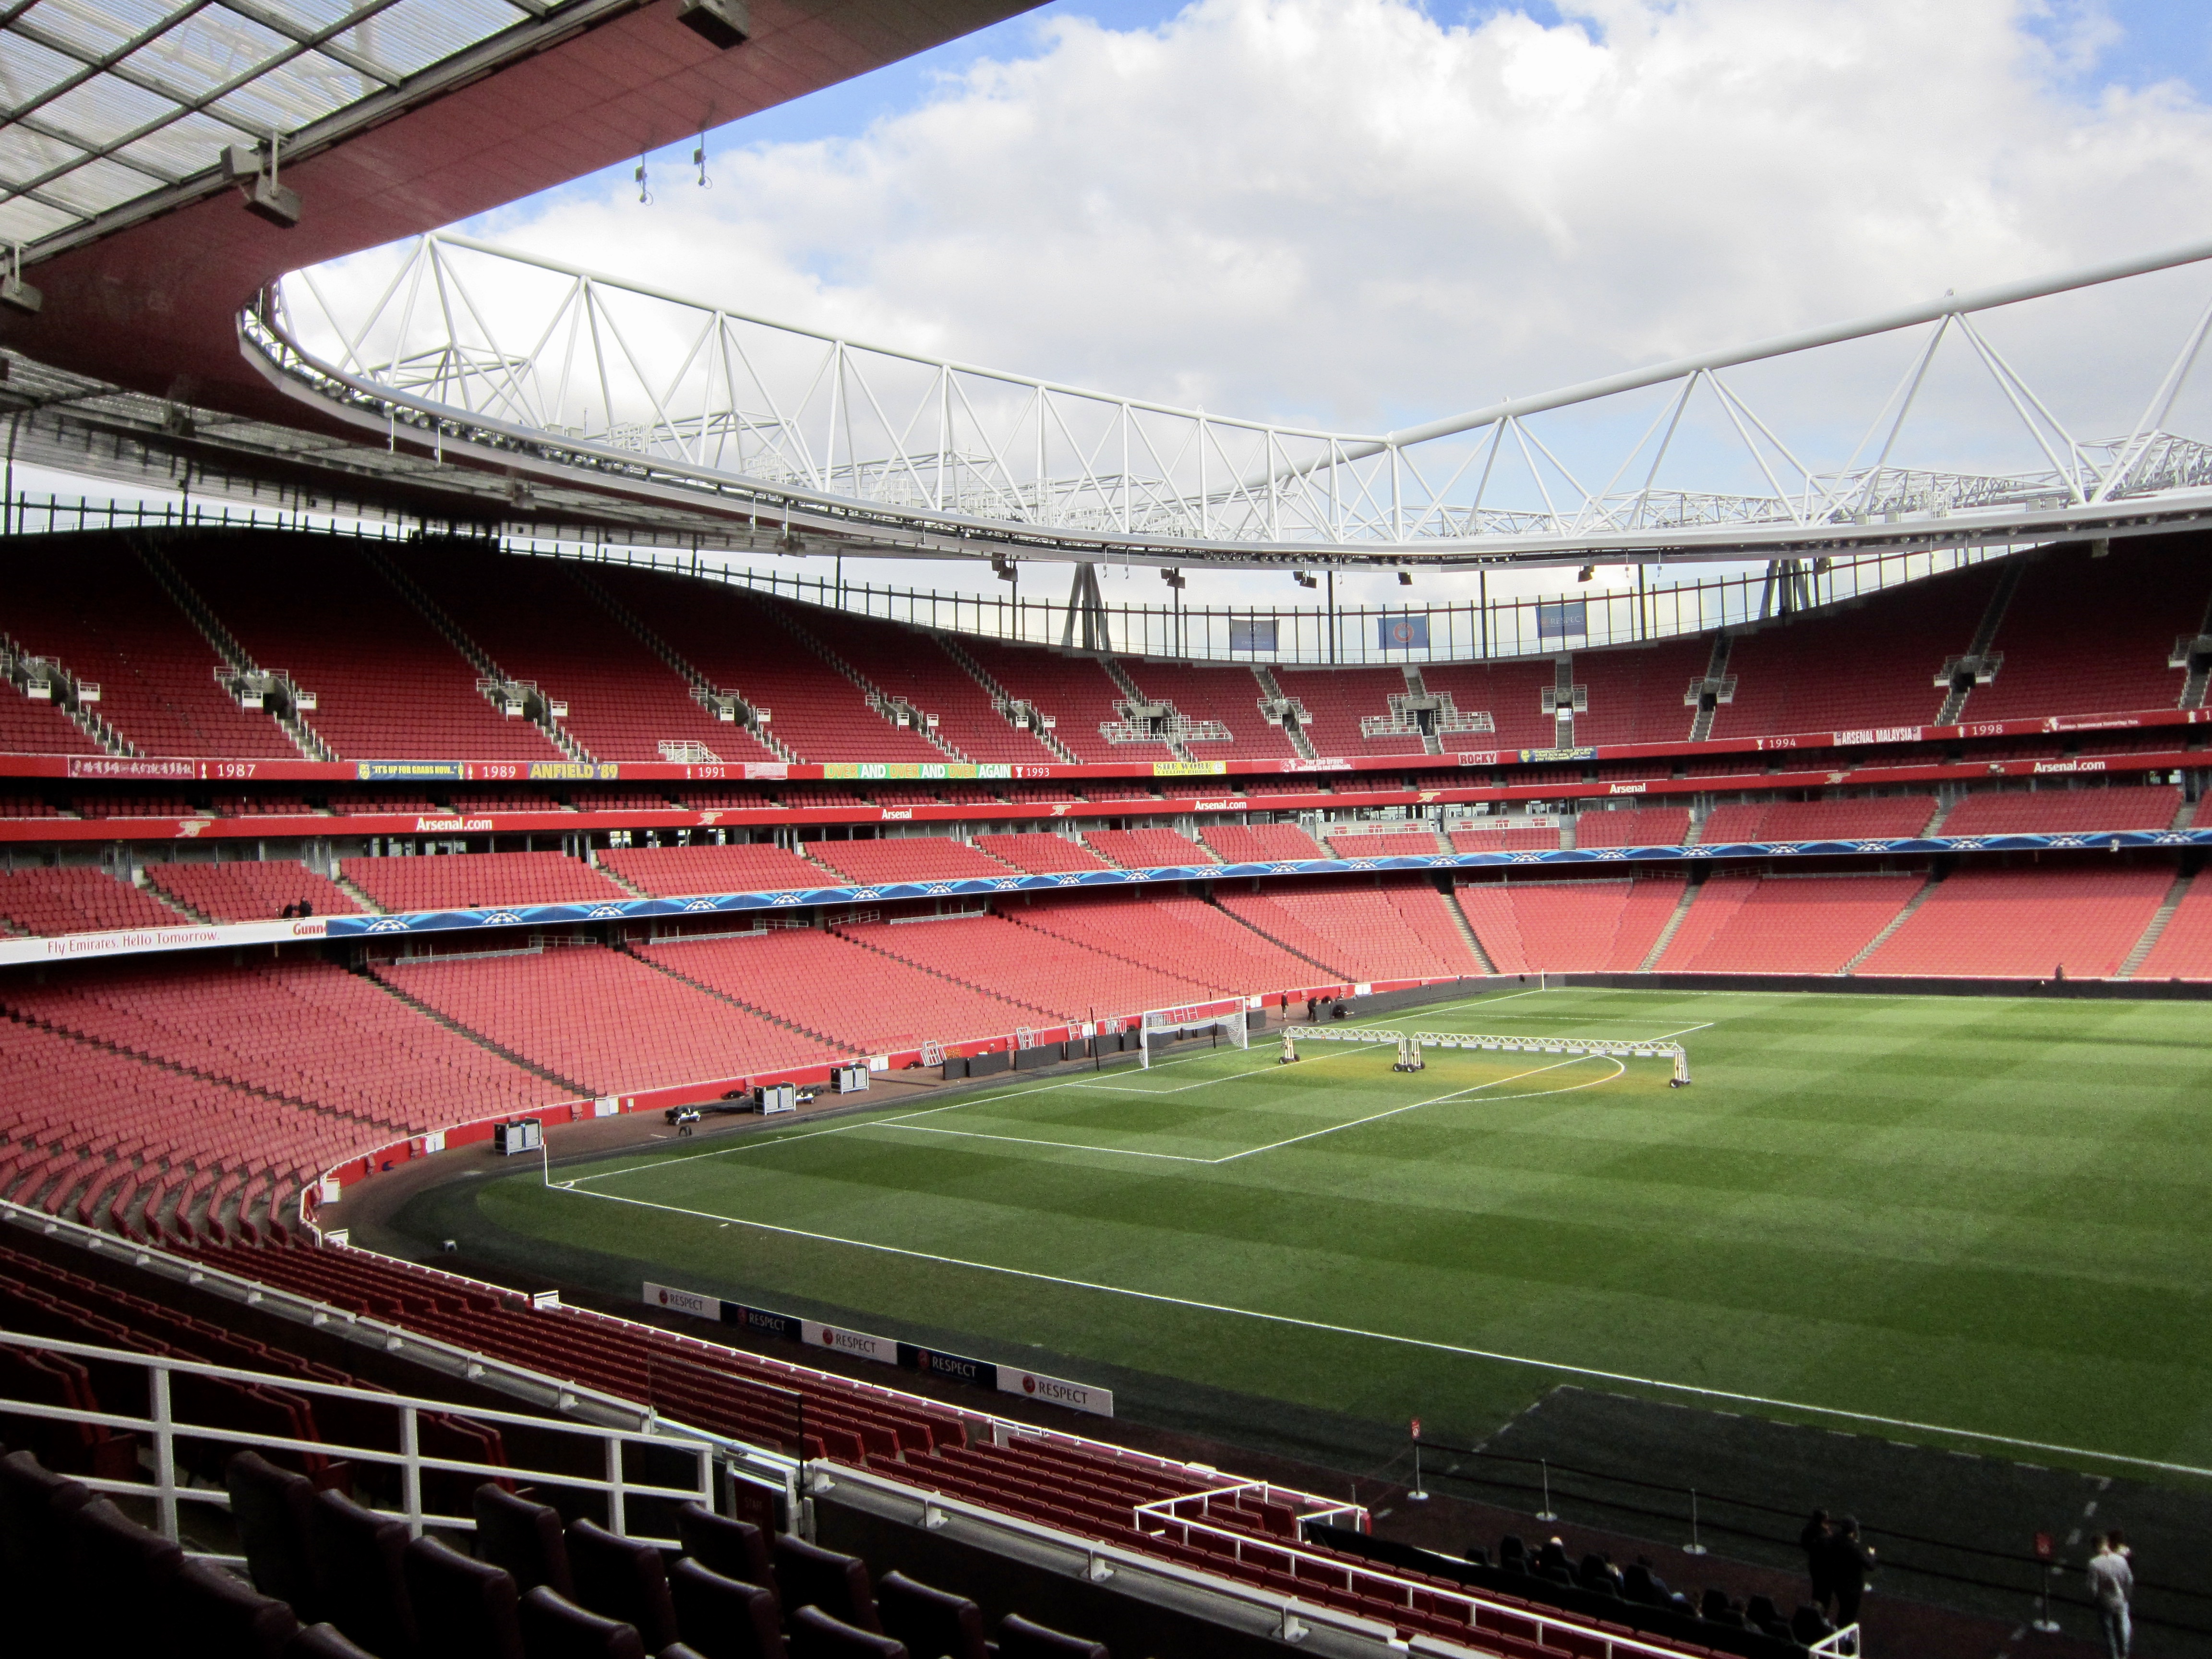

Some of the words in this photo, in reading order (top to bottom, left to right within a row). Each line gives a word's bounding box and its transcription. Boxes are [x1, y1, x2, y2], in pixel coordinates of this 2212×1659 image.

[1842, 730, 1874, 745] ARSENAL
[1876, 727, 1913, 742] MALAYSIA
[1972, 724, 2003, 735] 1998
[1769, 738, 1796, 748] 1994
[1460, 753, 1495, 765] ROCKY
[217, 763, 256, 778] 1987
[388, 766, 397, 774] UP
[398, 766, 411, 774] FOR
[412, 766, 434, 774] GRABS
[483, 765, 516, 778] 1989
[529, 763, 594, 779] ANFIELD
[698, 767, 725, 778] 1991
[827, 764, 858, 778] OVER
[860, 764, 887, 778] AND
[889, 764, 919, 778] OVER
[921, 764, 946, 778] AND
[948, 764, 976, 778] OVER
[978, 764, 1010, 778] AGAIN
[1026, 767, 1050, 777] 1993
[2033, 760, 2105, 773] Arsenal.com
[1609, 782, 1646, 793] Arsenal
[1194, 799, 1247, 810] Arsenal.com
[881, 808, 912, 819] Arsenal
[416, 817, 493, 830] Arsenal.com
[48, 940, 66, 955] Fly
[123, 934, 152, 948] Hello
[156, 931, 220, 944] Tomorrow.
[670, 1293, 703, 1311] RESPECT
[749, 1312, 786, 1332] RESPECT
[836, 1334, 876, 1353] RESPECT
[932, 1356, 976, 1378] RESPECT
[1039, 1381, 1088, 1404] RESPECT
